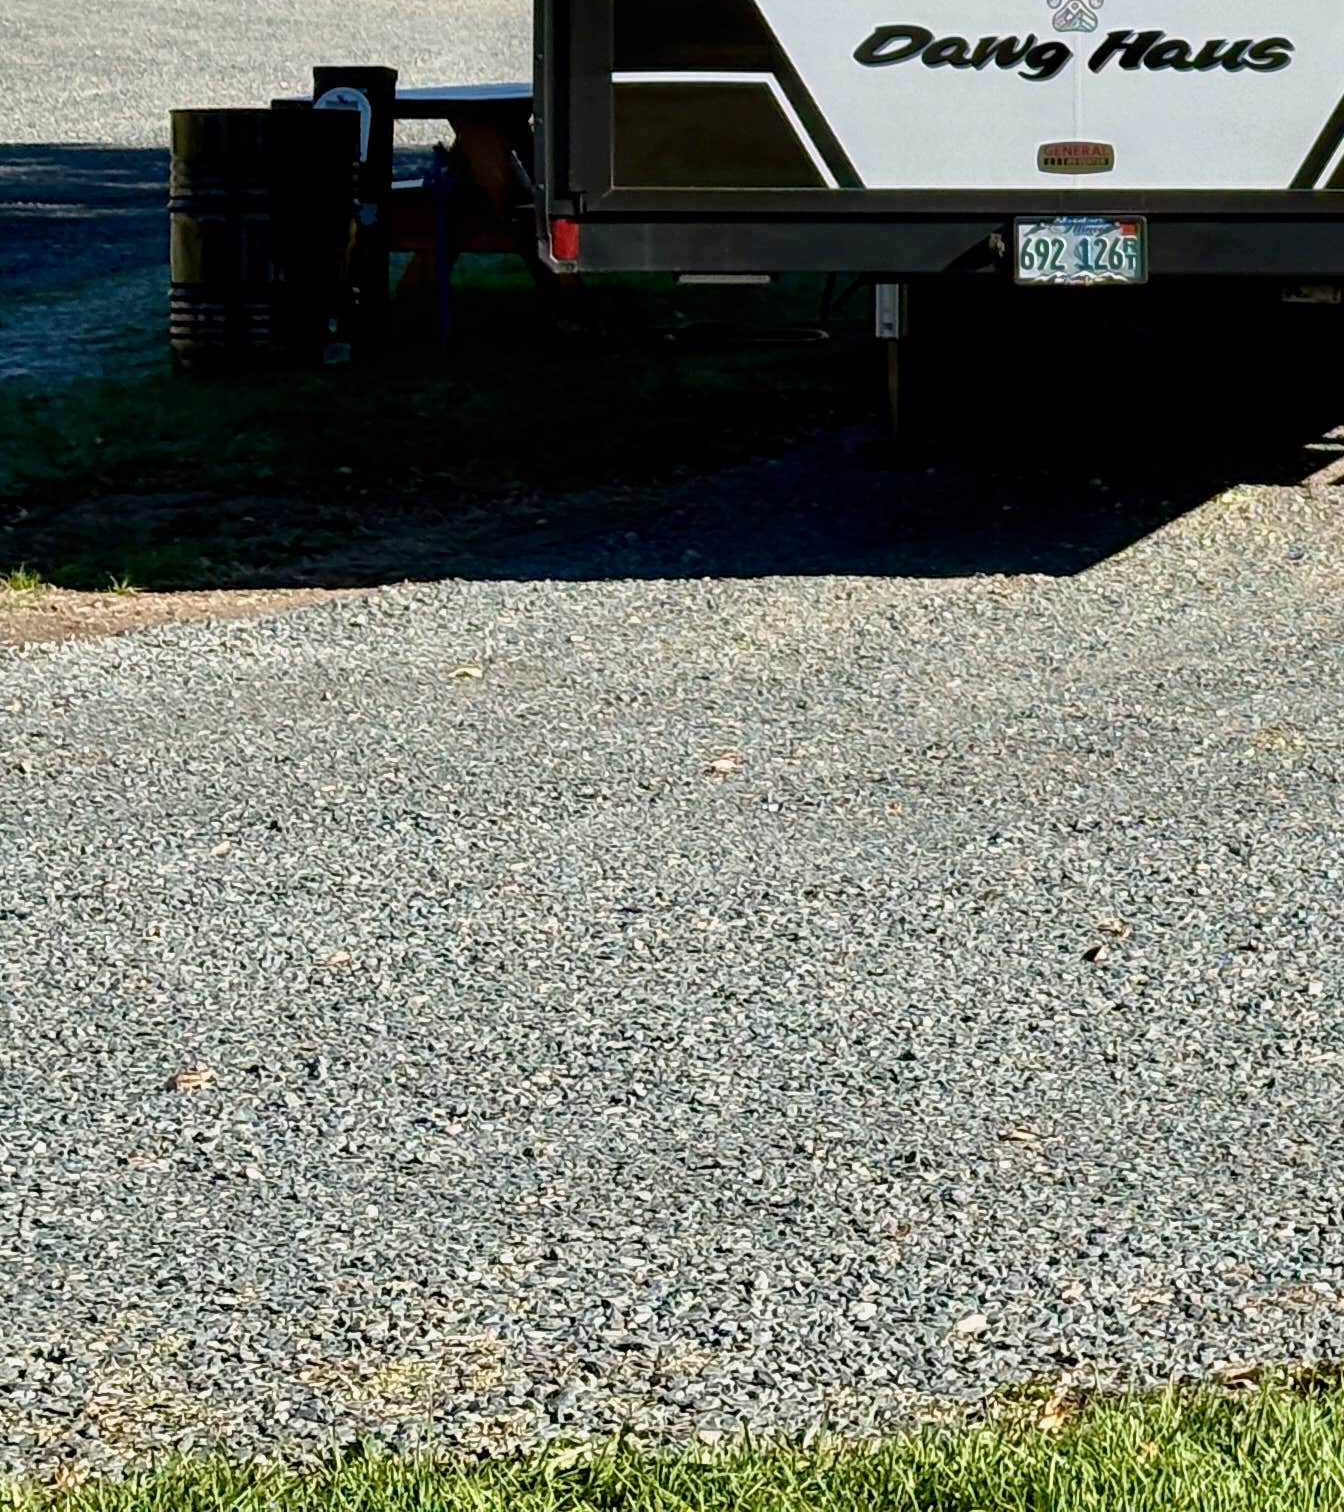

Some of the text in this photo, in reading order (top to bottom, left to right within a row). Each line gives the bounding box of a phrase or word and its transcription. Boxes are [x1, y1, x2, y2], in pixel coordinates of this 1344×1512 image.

[852, 23, 1295, 82] Dawg Haus
[1044, 144, 1110, 157] GENERAL
[1021, 238, 1067, 270] 692
[1077, 238, 1124, 270] 126
